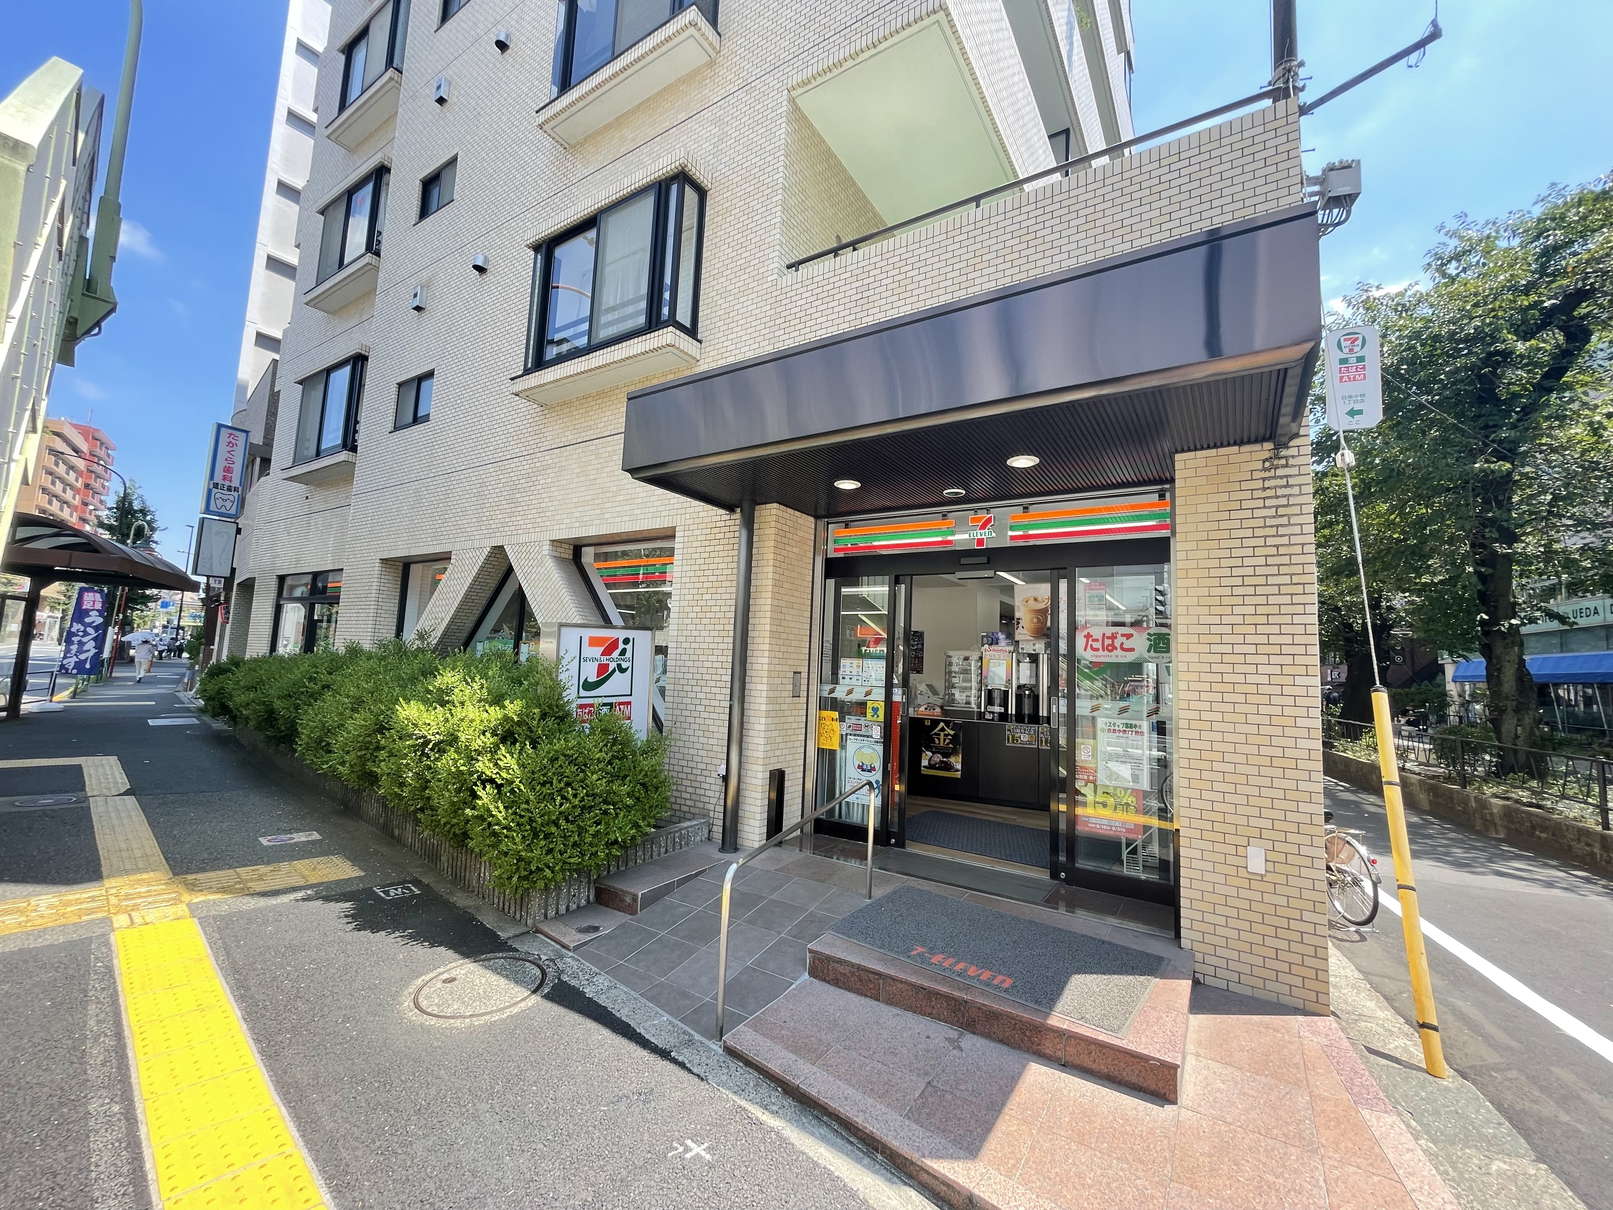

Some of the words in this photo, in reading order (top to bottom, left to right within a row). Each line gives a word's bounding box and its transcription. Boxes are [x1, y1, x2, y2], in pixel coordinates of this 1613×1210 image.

[1342, 374, 1364, 382] ATM
[222, 431, 240, 483] たかくら歯科
[1572, 606, 1600, 620] UEDA
[78, 610, 104, 669] ランチ
[1083, 631, 1136, 653] たばこ
[1146, 632, 1171, 654] 酒
[614, 703, 631, 720] ATM
[930, 721, 956, 748] 金
